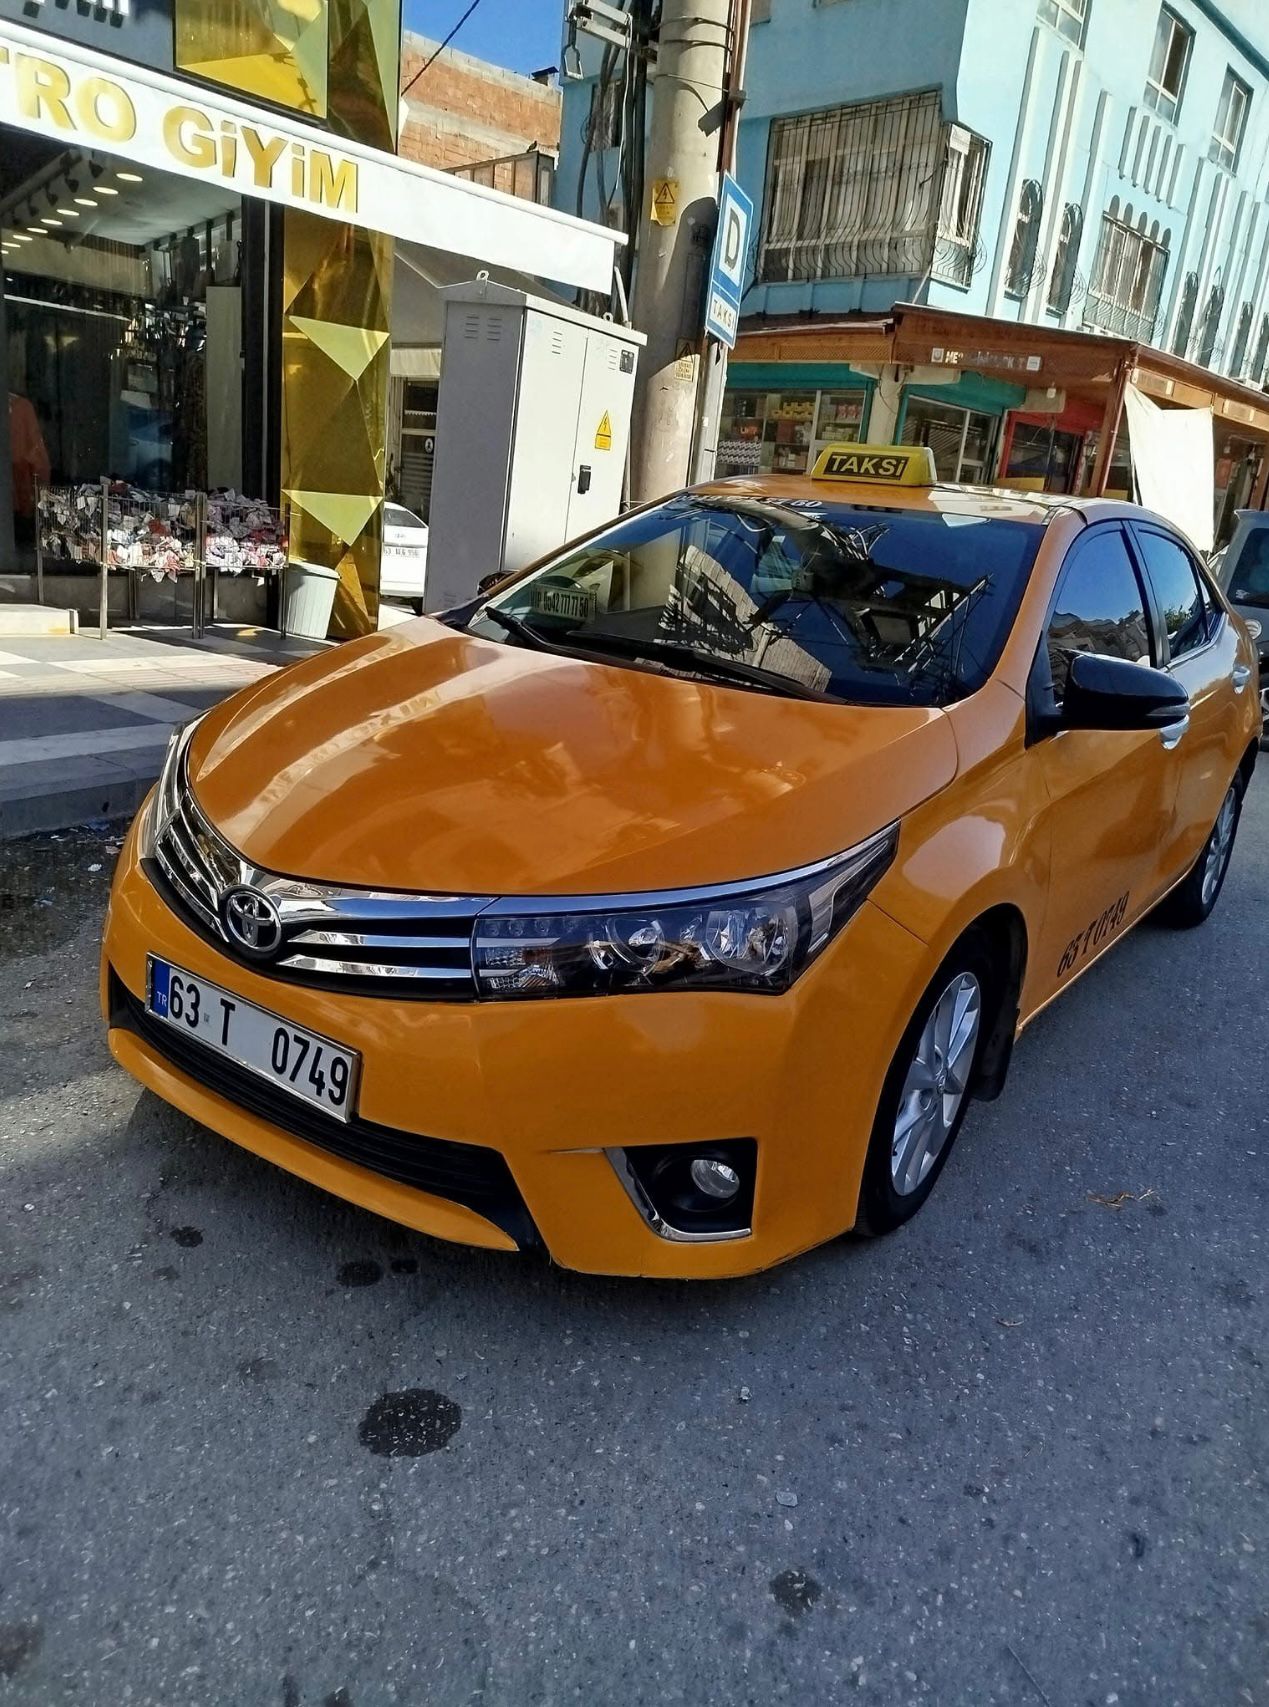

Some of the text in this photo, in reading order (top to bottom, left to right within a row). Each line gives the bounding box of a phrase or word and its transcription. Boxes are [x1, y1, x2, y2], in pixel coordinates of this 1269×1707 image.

[724, 207, 741, 272] D
[157, 990, 168, 1007] TR
[169, 975, 349, 1106] 63 T 0749
